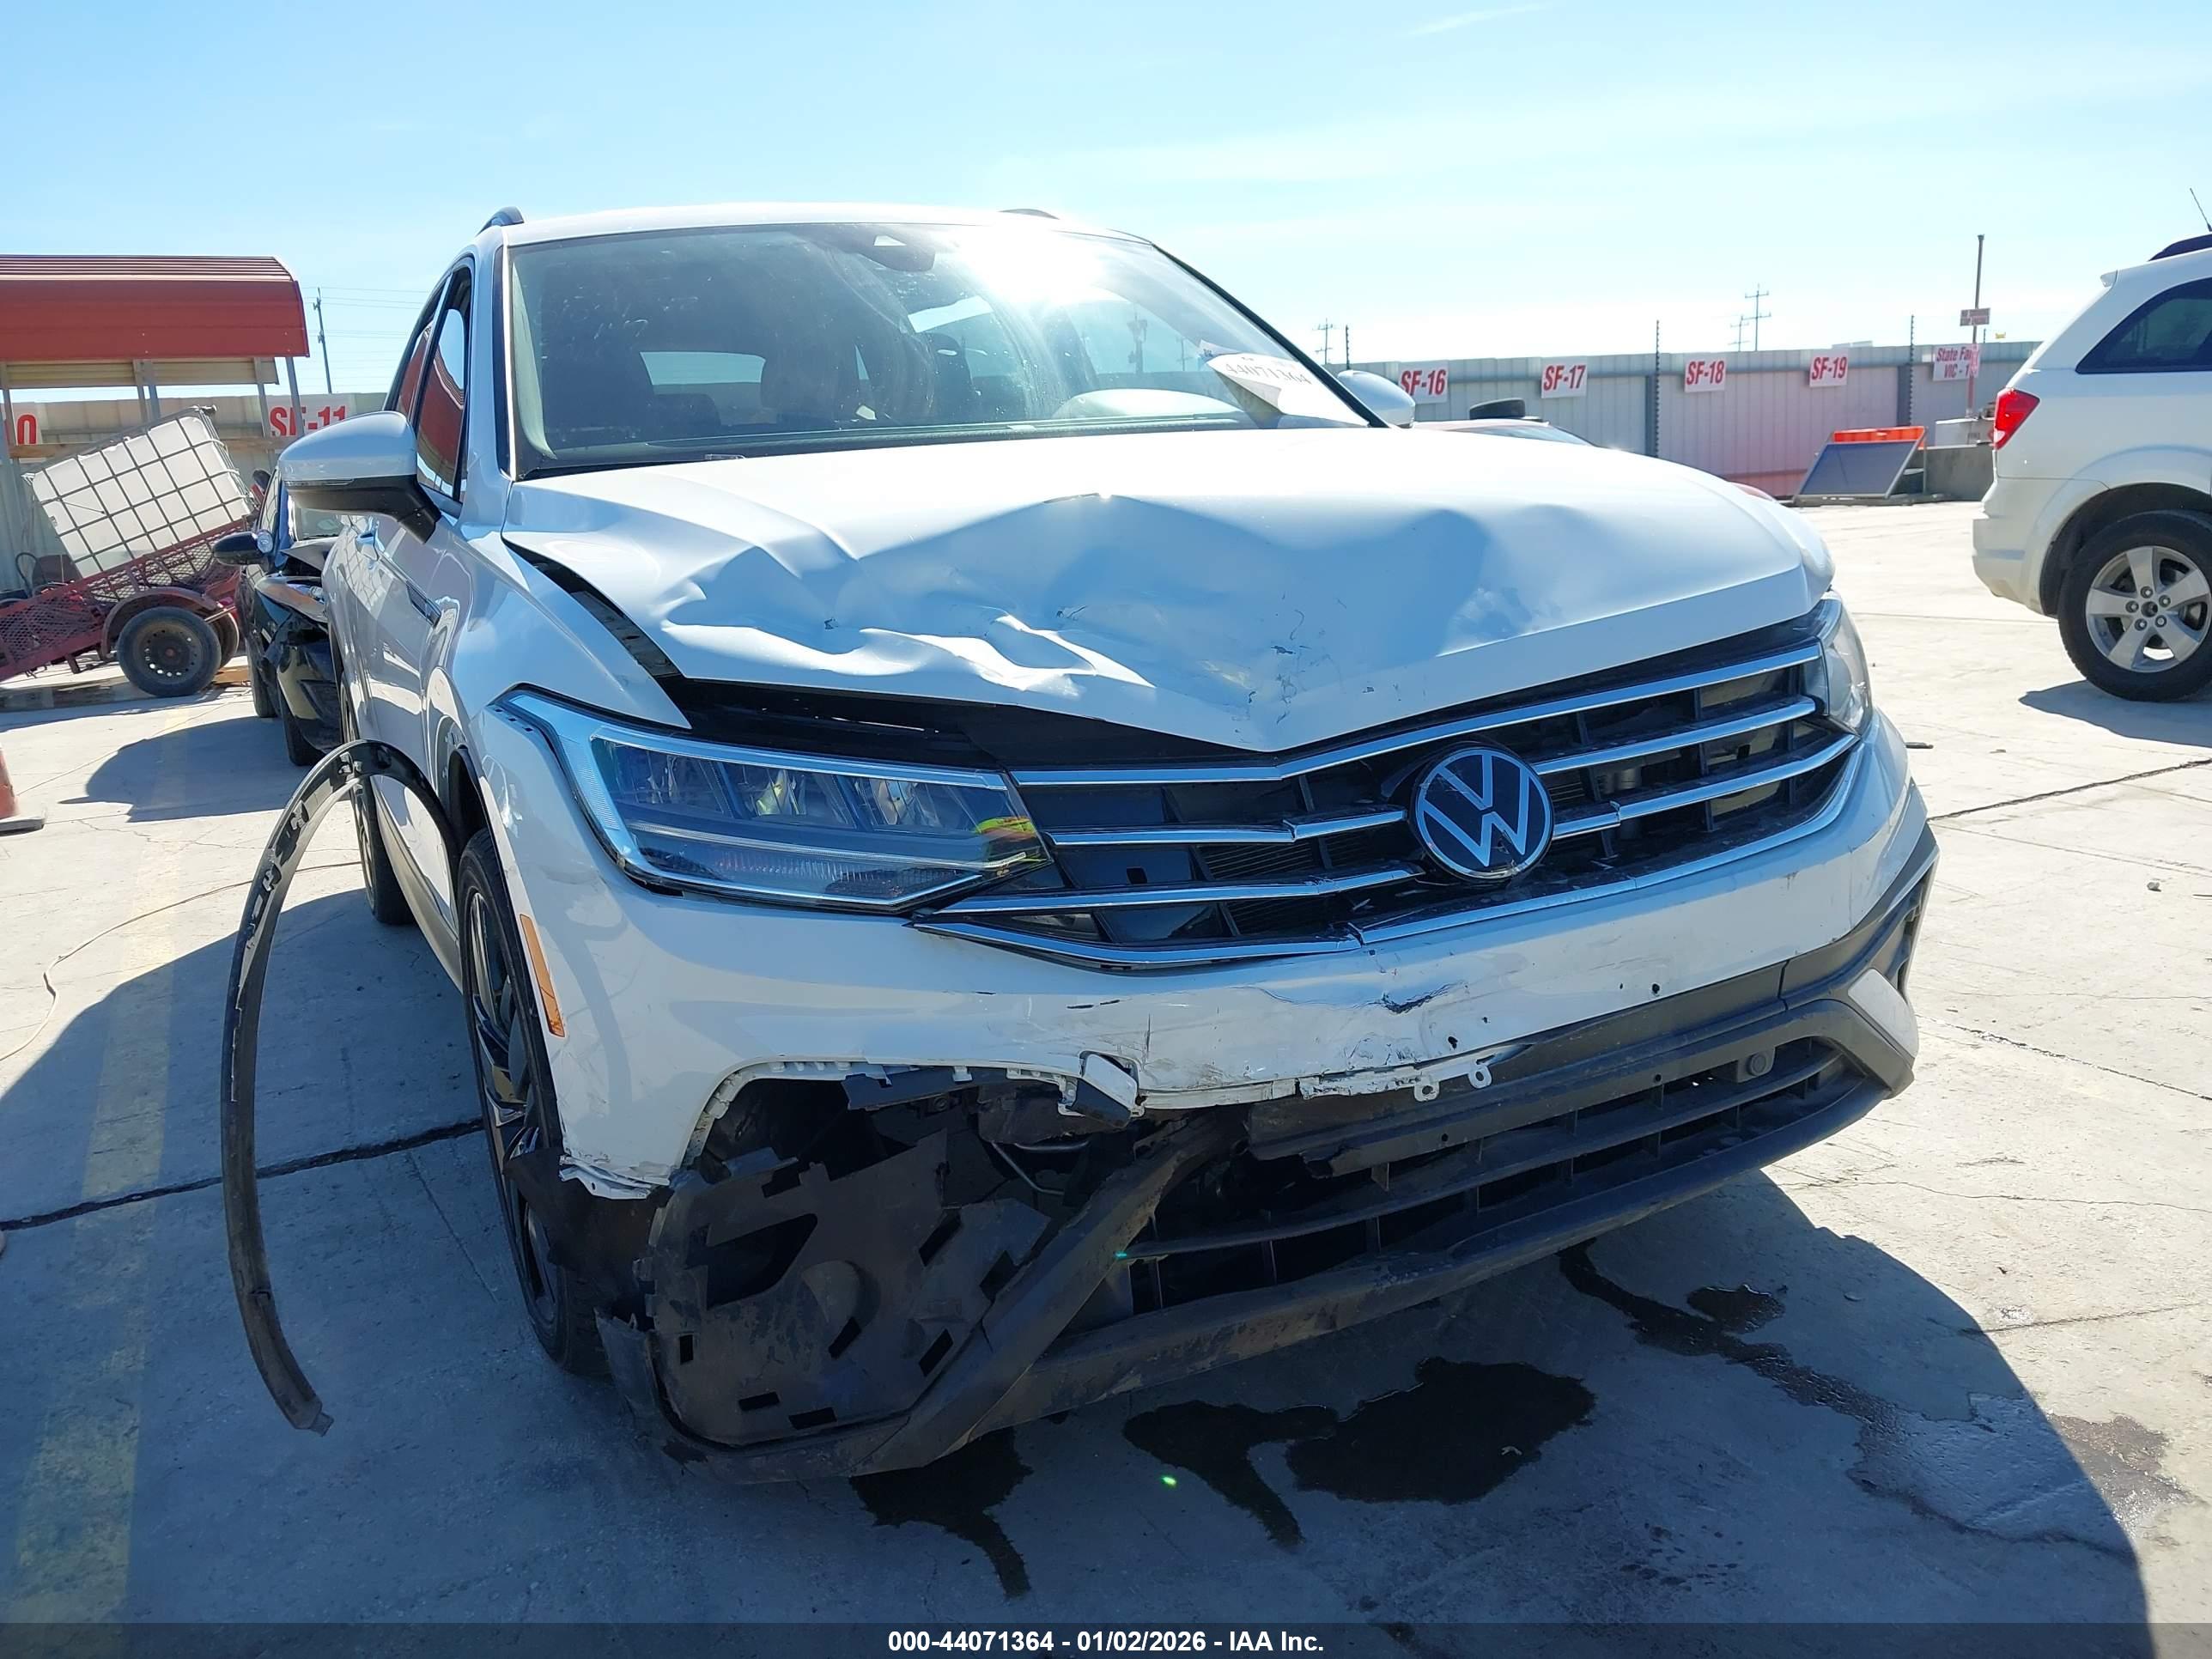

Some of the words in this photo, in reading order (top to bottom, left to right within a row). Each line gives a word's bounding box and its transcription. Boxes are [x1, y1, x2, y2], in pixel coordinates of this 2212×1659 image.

[1543, 364, 1587, 391] SF-17
[1686, 360, 1725, 386] SF-18
[1810, 356, 1847, 380] SF-19
[1400, 369, 1447, 396] SF-16
[1419, 749, 1539, 871] VW
